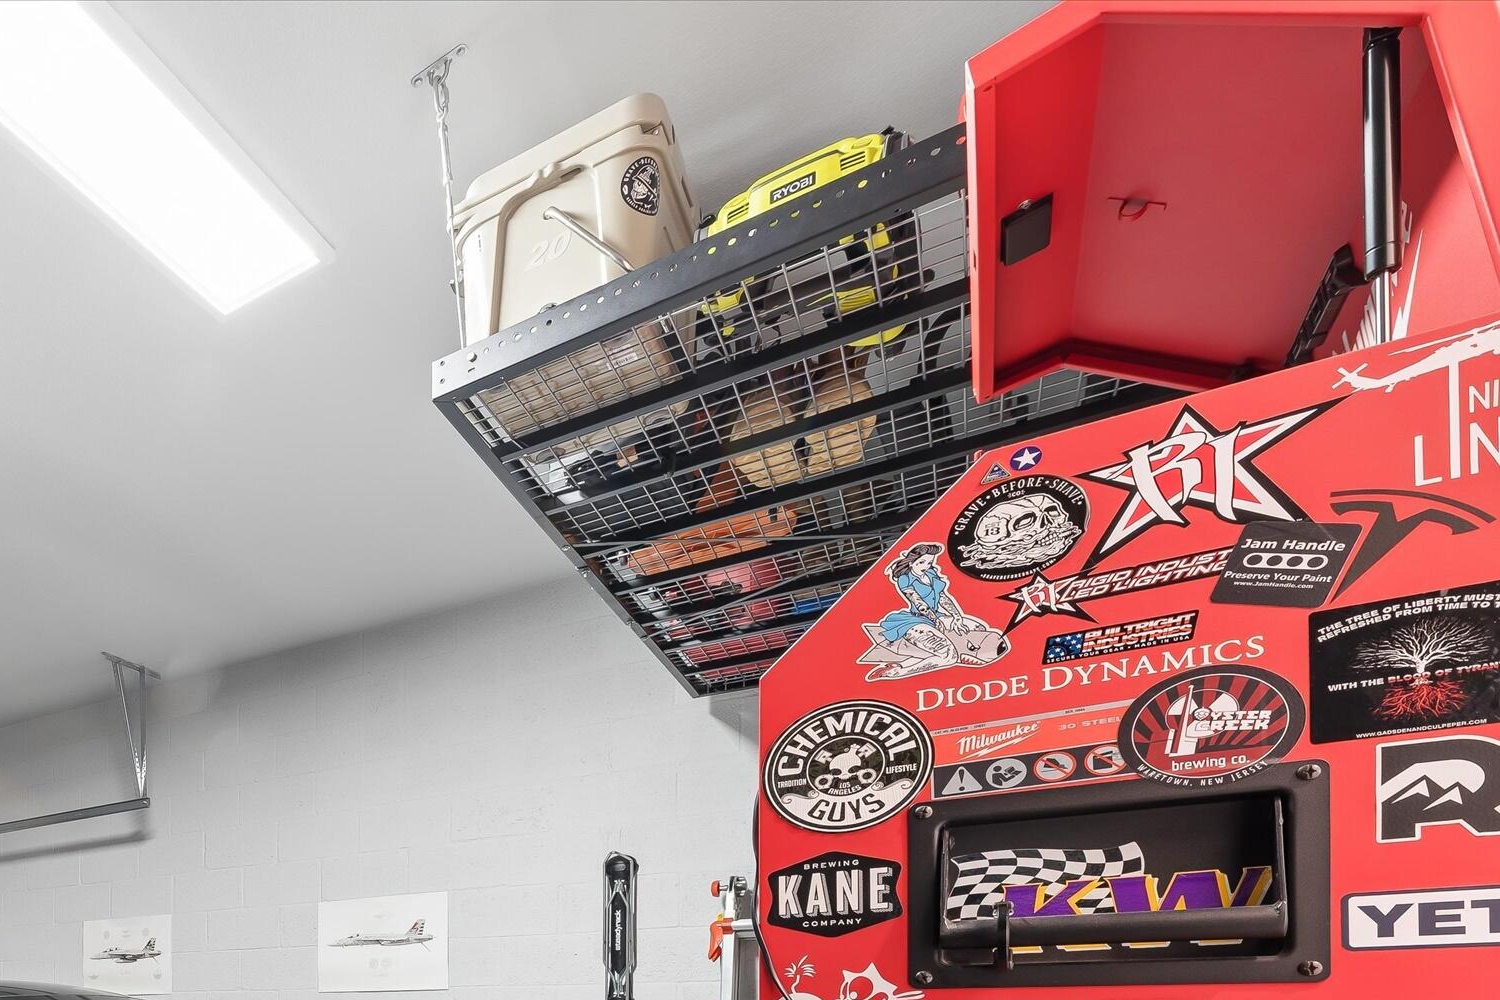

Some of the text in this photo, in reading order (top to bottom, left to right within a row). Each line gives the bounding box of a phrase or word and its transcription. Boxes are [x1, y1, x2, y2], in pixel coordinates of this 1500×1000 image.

[772, 177, 814, 201] RYOBI
[957, 476, 1083, 532] GRAVE BEFORE SHAVE
[1241, 539, 1346, 552] Jam Handle
[1069, 568, 1131, 590] RIGID
[1224, 571, 1332, 583] Preserve Your Paint
[1084, 613, 1196, 641] BUILTRIGHT
[1317, 620, 1343, 635] THE
[1345, 609, 1380, 626] TREE
[1382, 604, 1401, 615] OF
[1404, 595, 1461, 610] LIBERTY
[1317, 613, 1392, 643] REFRESHED
[1395, 605, 1433, 619] FROM
[1436, 601, 1468, 611] TIME
[1471, 600, 1490, 609] TO
[1046, 635, 1190, 664] SECURE YOUR GEAR MADE IN USA
[1082, 624, 1193, 652] INDUSTRIES
[915, 635, 1266, 712] DIODE DYNAMICS
[1328, 661, 1500, 692] WITH THE BLOOD OF TYRAN
[956, 722, 1040, 756] Milwaukee
[1194, 719, 1270, 731] CREEK
[777, 711, 917, 777] CHEMICAL
[777, 763, 917, 789] TRADITION LIFESTYLE
[1171, 754, 1250, 772] brewing co.
[1200, 759, 1269, 787] NEW JERSEY
[827, 784, 862, 795] ANGELES
[807, 793, 886, 822] GUYS
[803, 859, 860, 870] BREWING
[778, 866, 894, 919] KANE
[802, 917, 862, 928] COMPANY
[1357, 900, 1500, 938] YET
